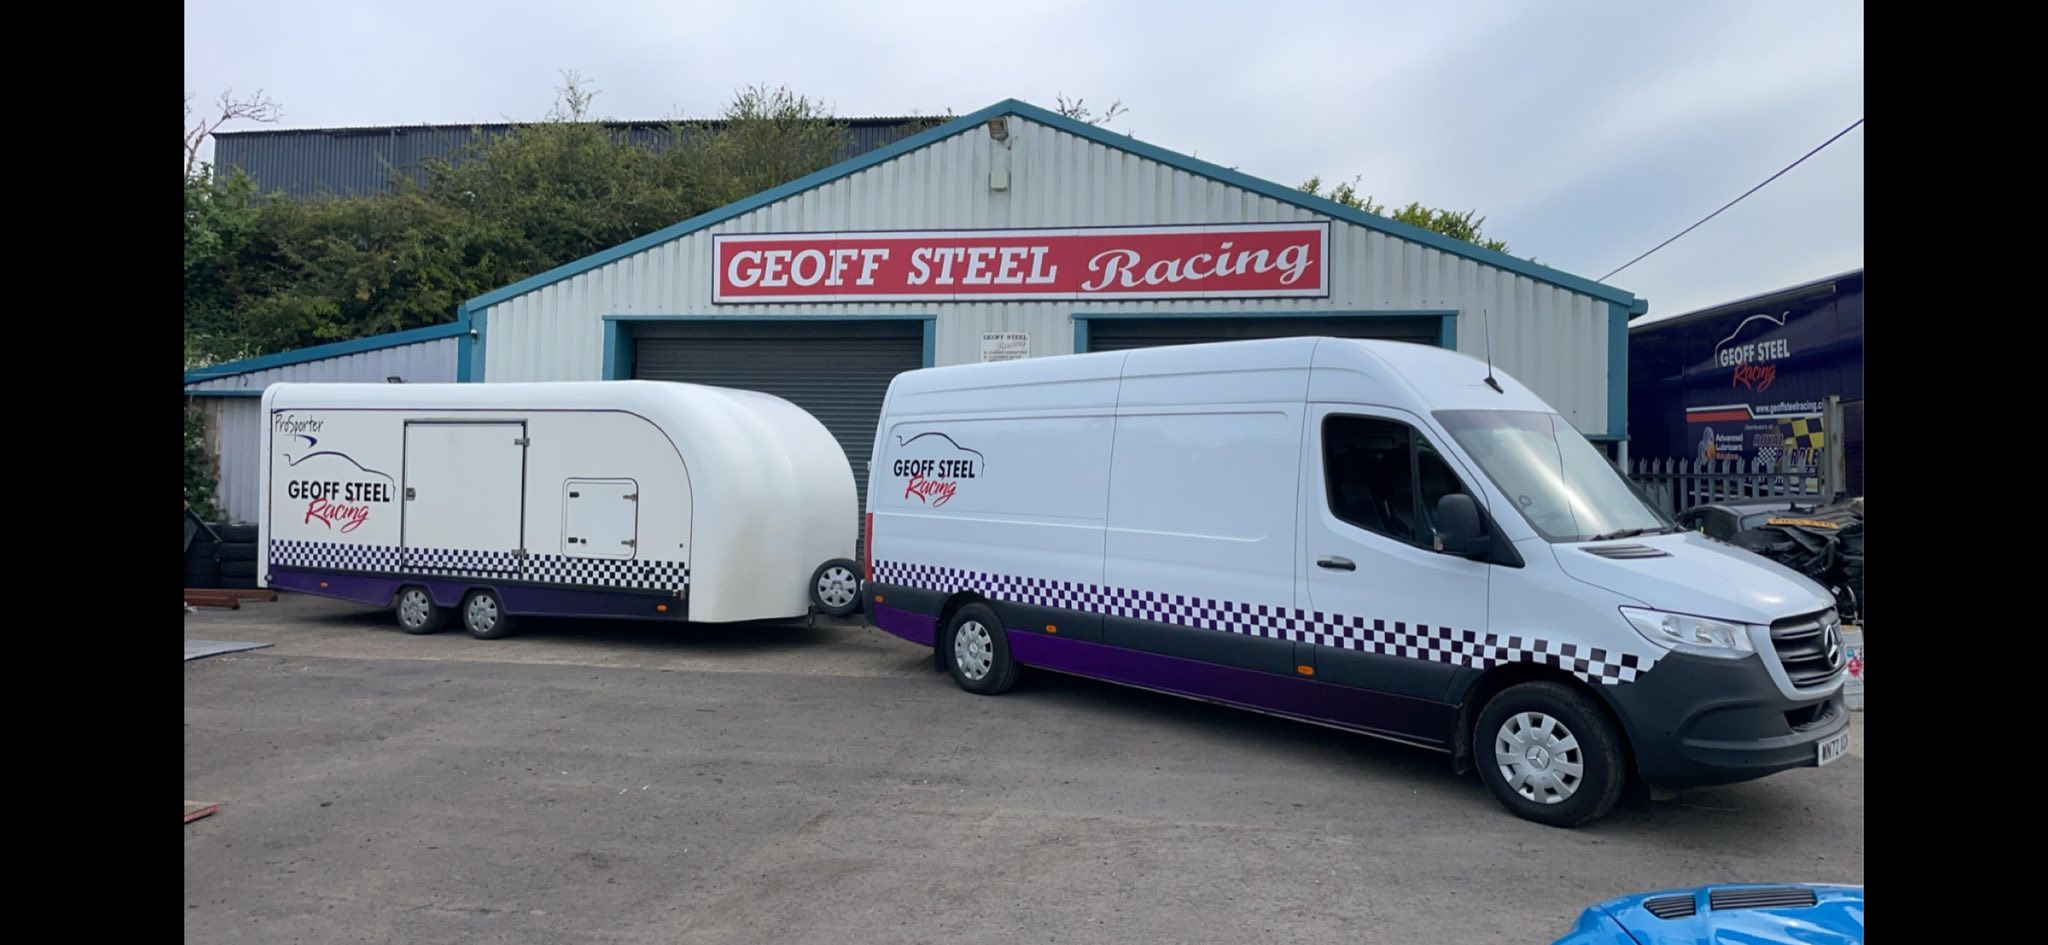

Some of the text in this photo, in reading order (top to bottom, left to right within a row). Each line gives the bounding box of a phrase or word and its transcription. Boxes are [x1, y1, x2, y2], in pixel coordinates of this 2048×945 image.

[727, 241, 1313, 292] GEOFF STEEL Racing
[1720, 339, 1790, 366] GEOFF STEEL
[1733, 361, 1776, 392] Racing
[275, 414, 324, 442] ProSporter
[1715, 433, 1743, 442] Advanced
[893, 459, 975, 478] GEOFF STEEL
[288, 479, 391, 503] GEOFF STEEL
[904, 472, 958, 508] Racing
[304, 497, 370, 534] Racing
